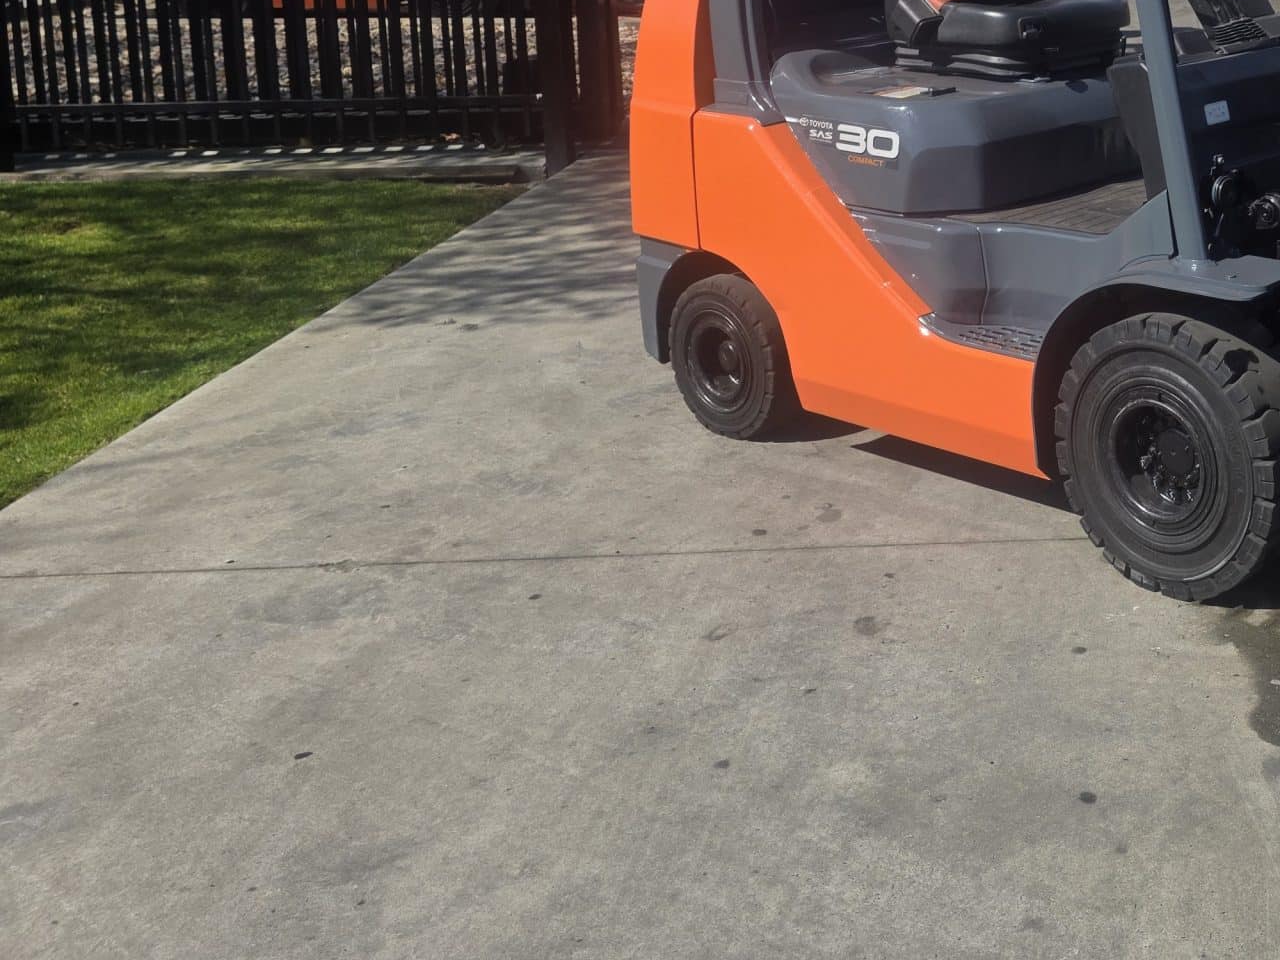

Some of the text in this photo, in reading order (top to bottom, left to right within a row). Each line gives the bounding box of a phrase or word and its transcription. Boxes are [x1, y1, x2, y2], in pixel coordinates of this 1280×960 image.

[809, 119, 834, 130] TOYOTA
[809, 129, 833, 140] SAS
[835, 123, 900, 159] 30
[847, 155, 884, 166] COMPACT
